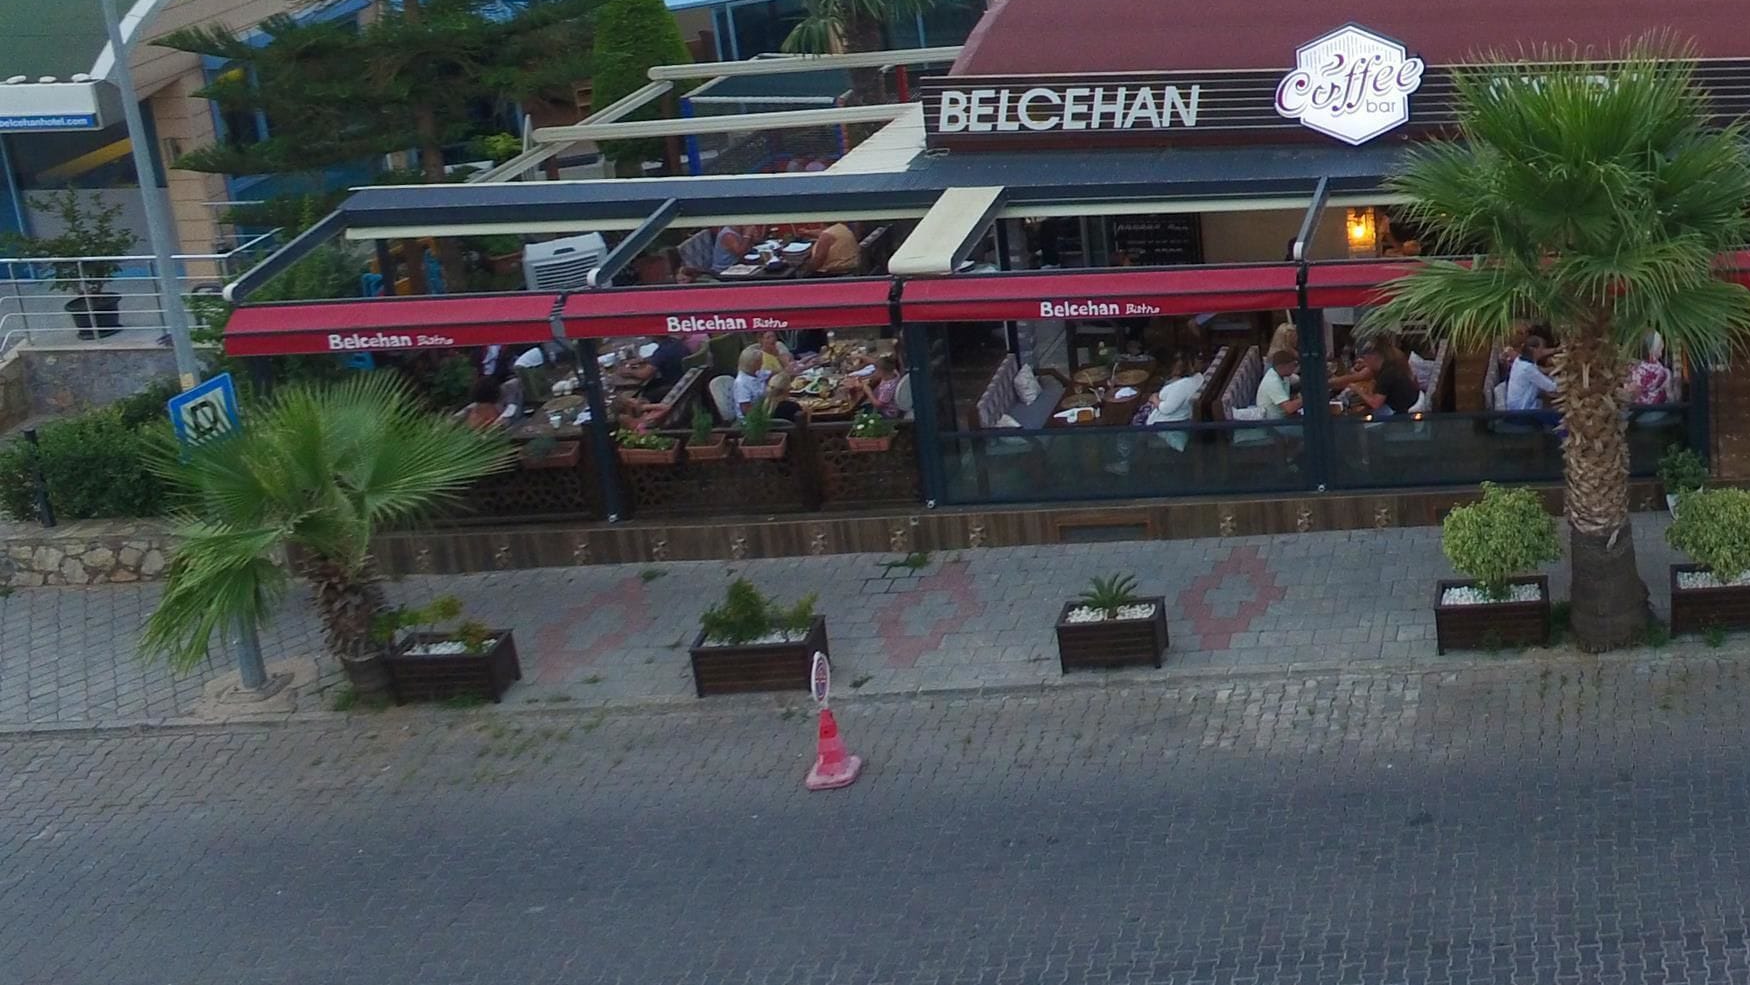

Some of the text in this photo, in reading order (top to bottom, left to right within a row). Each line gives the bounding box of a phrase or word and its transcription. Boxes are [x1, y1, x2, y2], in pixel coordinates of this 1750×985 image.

[1275, 54, 1421, 114] Coffee
[938, 84, 1201, 133] BELCEHAN
[1366, 99, 1397, 114] bar
[1039, 299, 1120, 317] Belcehan
[666, 314, 748, 332] Belcehan
[327, 331, 413, 350] Belcehan
